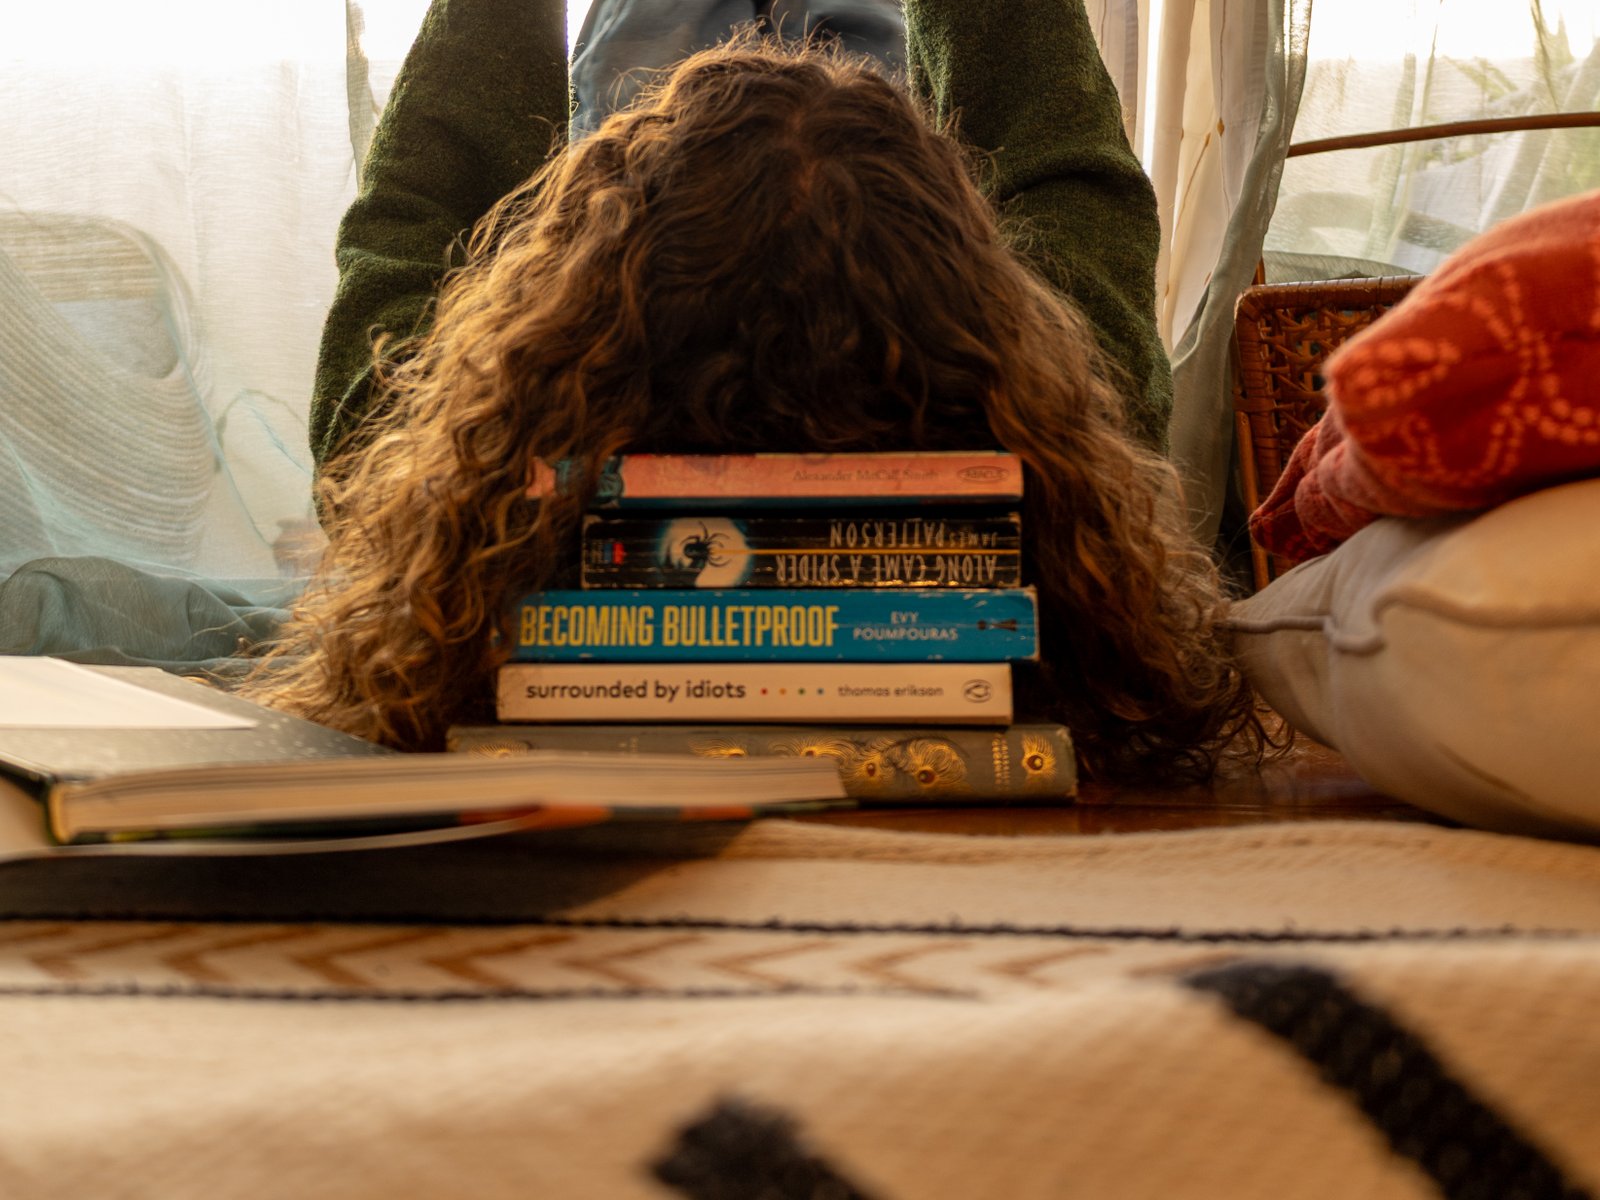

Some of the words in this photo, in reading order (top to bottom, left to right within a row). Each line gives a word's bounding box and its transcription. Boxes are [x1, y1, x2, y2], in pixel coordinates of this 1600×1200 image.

[793, 469, 851, 481] Alexander
[829, 521, 946, 548] PATTERSON
[949, 531, 998, 548] JAMES
[775, 554, 840, 582] SPIDER
[850, 554, 863, 582] A
[872, 554, 928, 582] CAME
[935, 554, 998, 582] ALONG
[519, 605, 654, 647] BECOMING
[662, 605, 839, 647] BULLETPROOF
[890, 611, 919, 625] EVY
[853, 627, 959, 641] POUMPOURAS
[525, 680, 648, 699] surrounded
[654, 680, 680, 703] by
[686, 680, 746, 699] idiots
[837, 684, 890, 697] thomas
[893, 684, 944, 697] erikson
